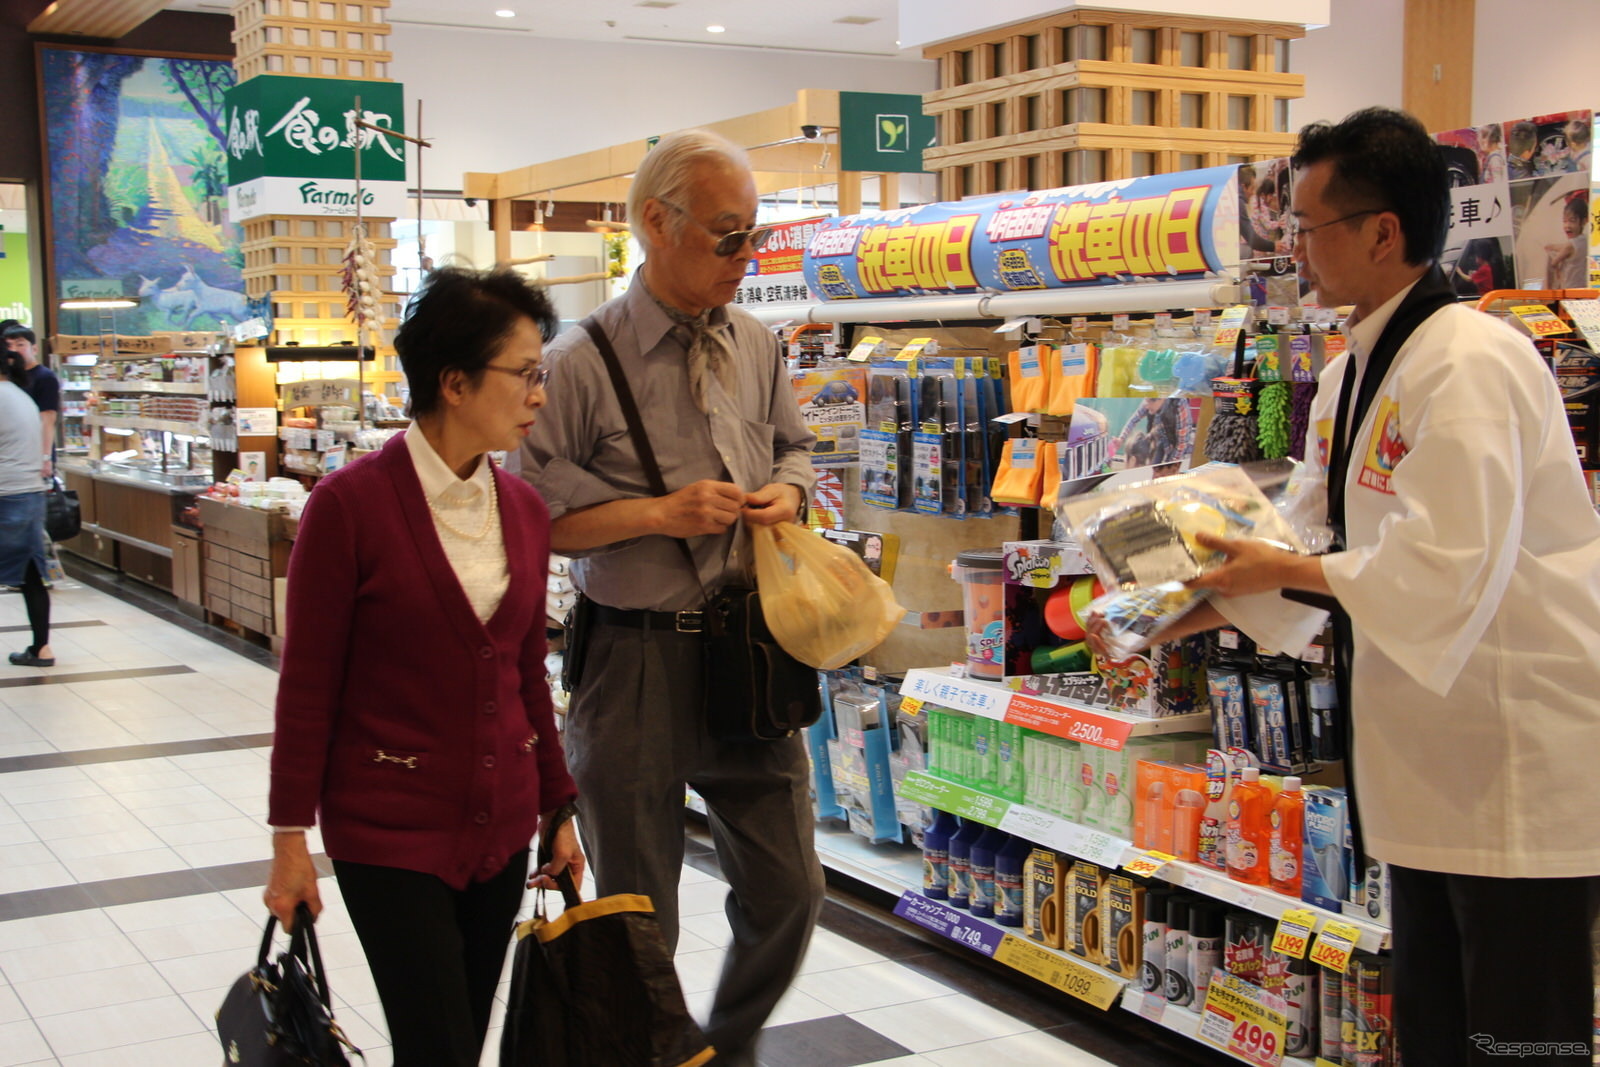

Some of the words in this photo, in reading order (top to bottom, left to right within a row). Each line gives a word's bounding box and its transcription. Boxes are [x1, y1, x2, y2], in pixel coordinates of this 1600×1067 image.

[265, 96, 405, 162] 食の駅
[299, 181, 375, 206] Farmdo
[1049, 185, 1211, 282] 洗車の日
[857, 214, 981, 293] 洗車の日
[1007, 550, 1051, 580] Splatoon
[1034, 872, 1054, 885] GOLD
[1076, 885, 1097, 898] GOLD
[1111, 899, 1131, 913] GOLD
[959, 926, 982, 946] 749
[1232, 1020, 1277, 1061] 499
